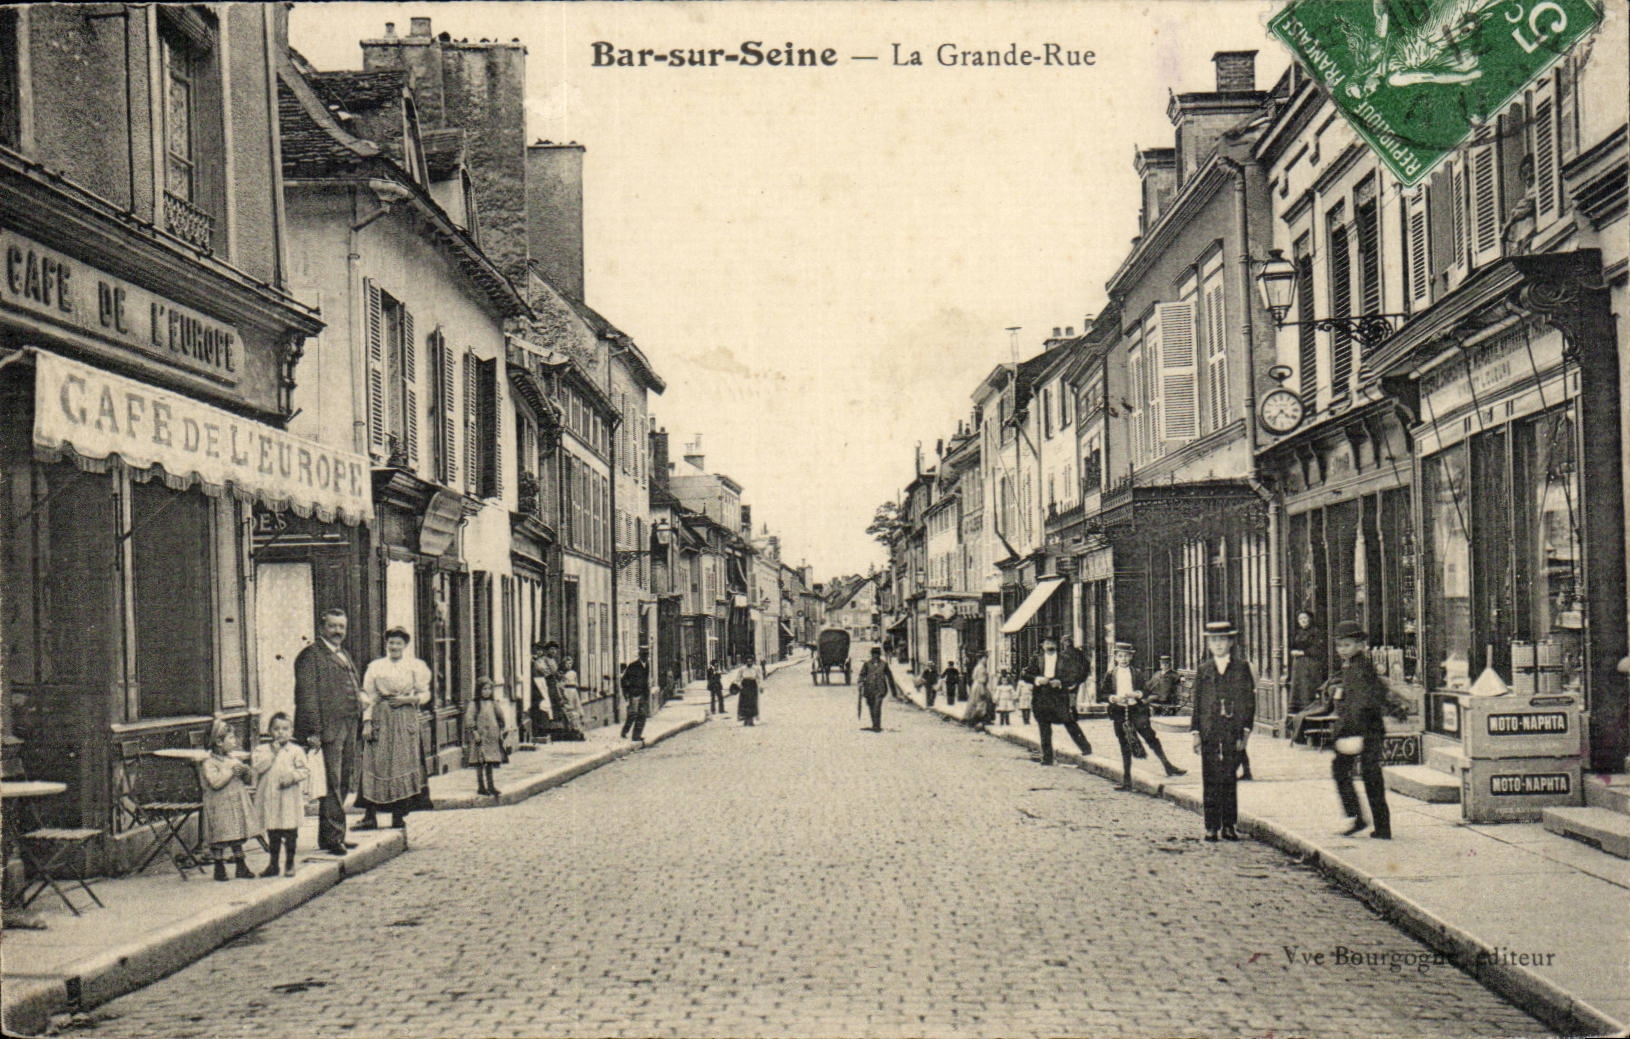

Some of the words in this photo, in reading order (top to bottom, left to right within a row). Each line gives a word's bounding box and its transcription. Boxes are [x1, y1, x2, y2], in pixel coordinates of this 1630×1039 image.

[98, 280, 128, 335] DE
[181, 416, 221, 459] DE
[230, 424, 365, 498] L'EUROPE
